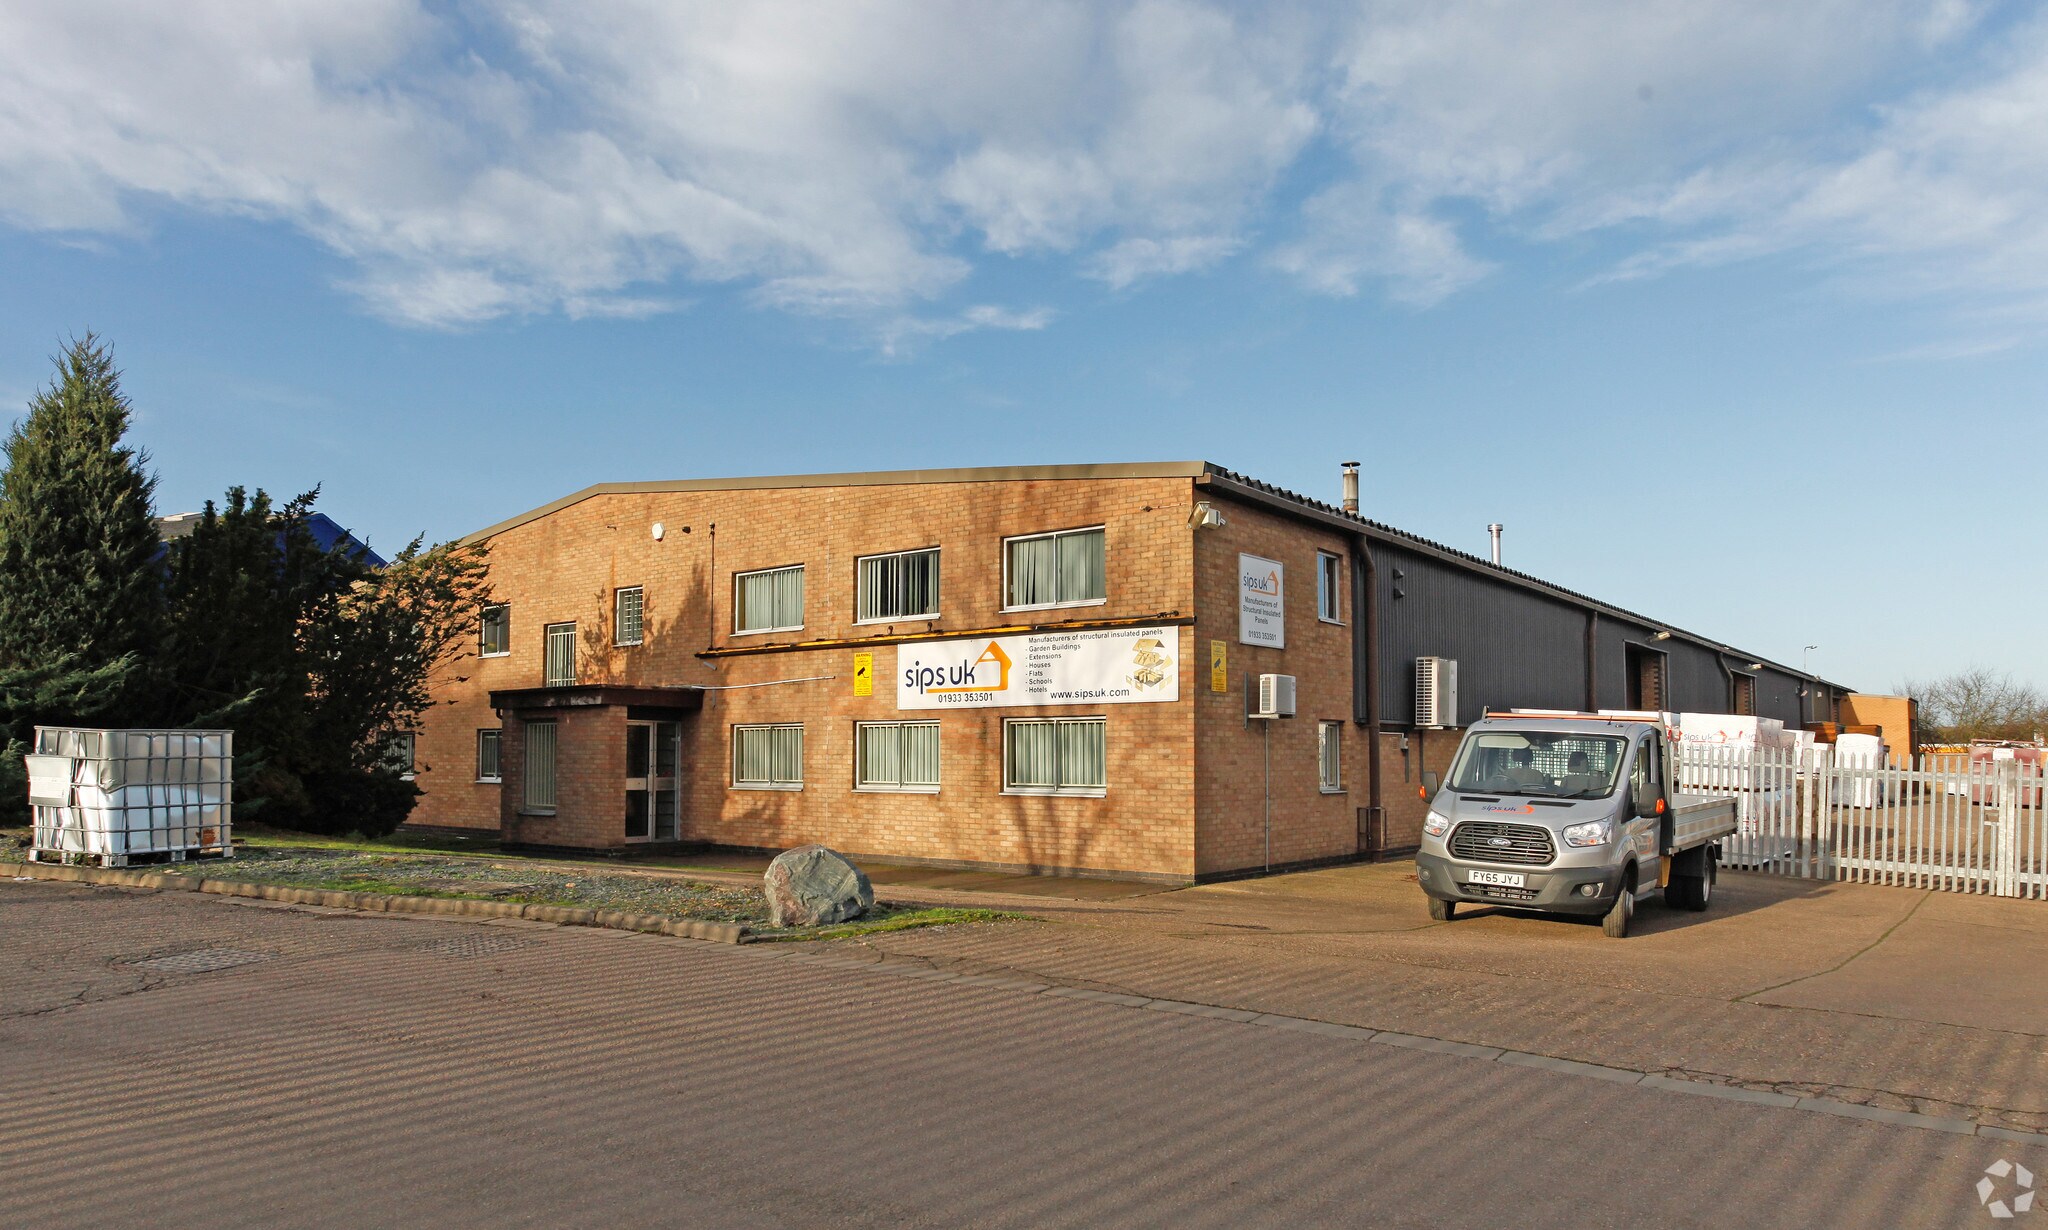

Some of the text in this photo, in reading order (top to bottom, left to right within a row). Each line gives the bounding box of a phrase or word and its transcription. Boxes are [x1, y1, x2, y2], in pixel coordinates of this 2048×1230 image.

[1243, 572, 1268, 591] sips uk
[1244, 596, 1273, 608] Manufacturers
[1243, 605, 1281, 618] Structural Insulated
[1254, 616, 1269, 625] Panels
[1029, 635, 1071, 644] Manufacturers
[1080, 632, 1110, 641] structural
[1110, 630, 1140, 638] insulated
[1141, 628, 1163, 637] panels
[1248, 630, 1277, 641] 01933 353501
[1029, 653, 1062, 661] Extensions
[905, 660, 945, 695] sips
[950, 659, 975, 685] uk
[938, 692, 993, 703] 01933 353501
[1050, 688, 1130, 700] www.sips.uk.com
[1473, 871, 1520, 886] FY65 JYJ
